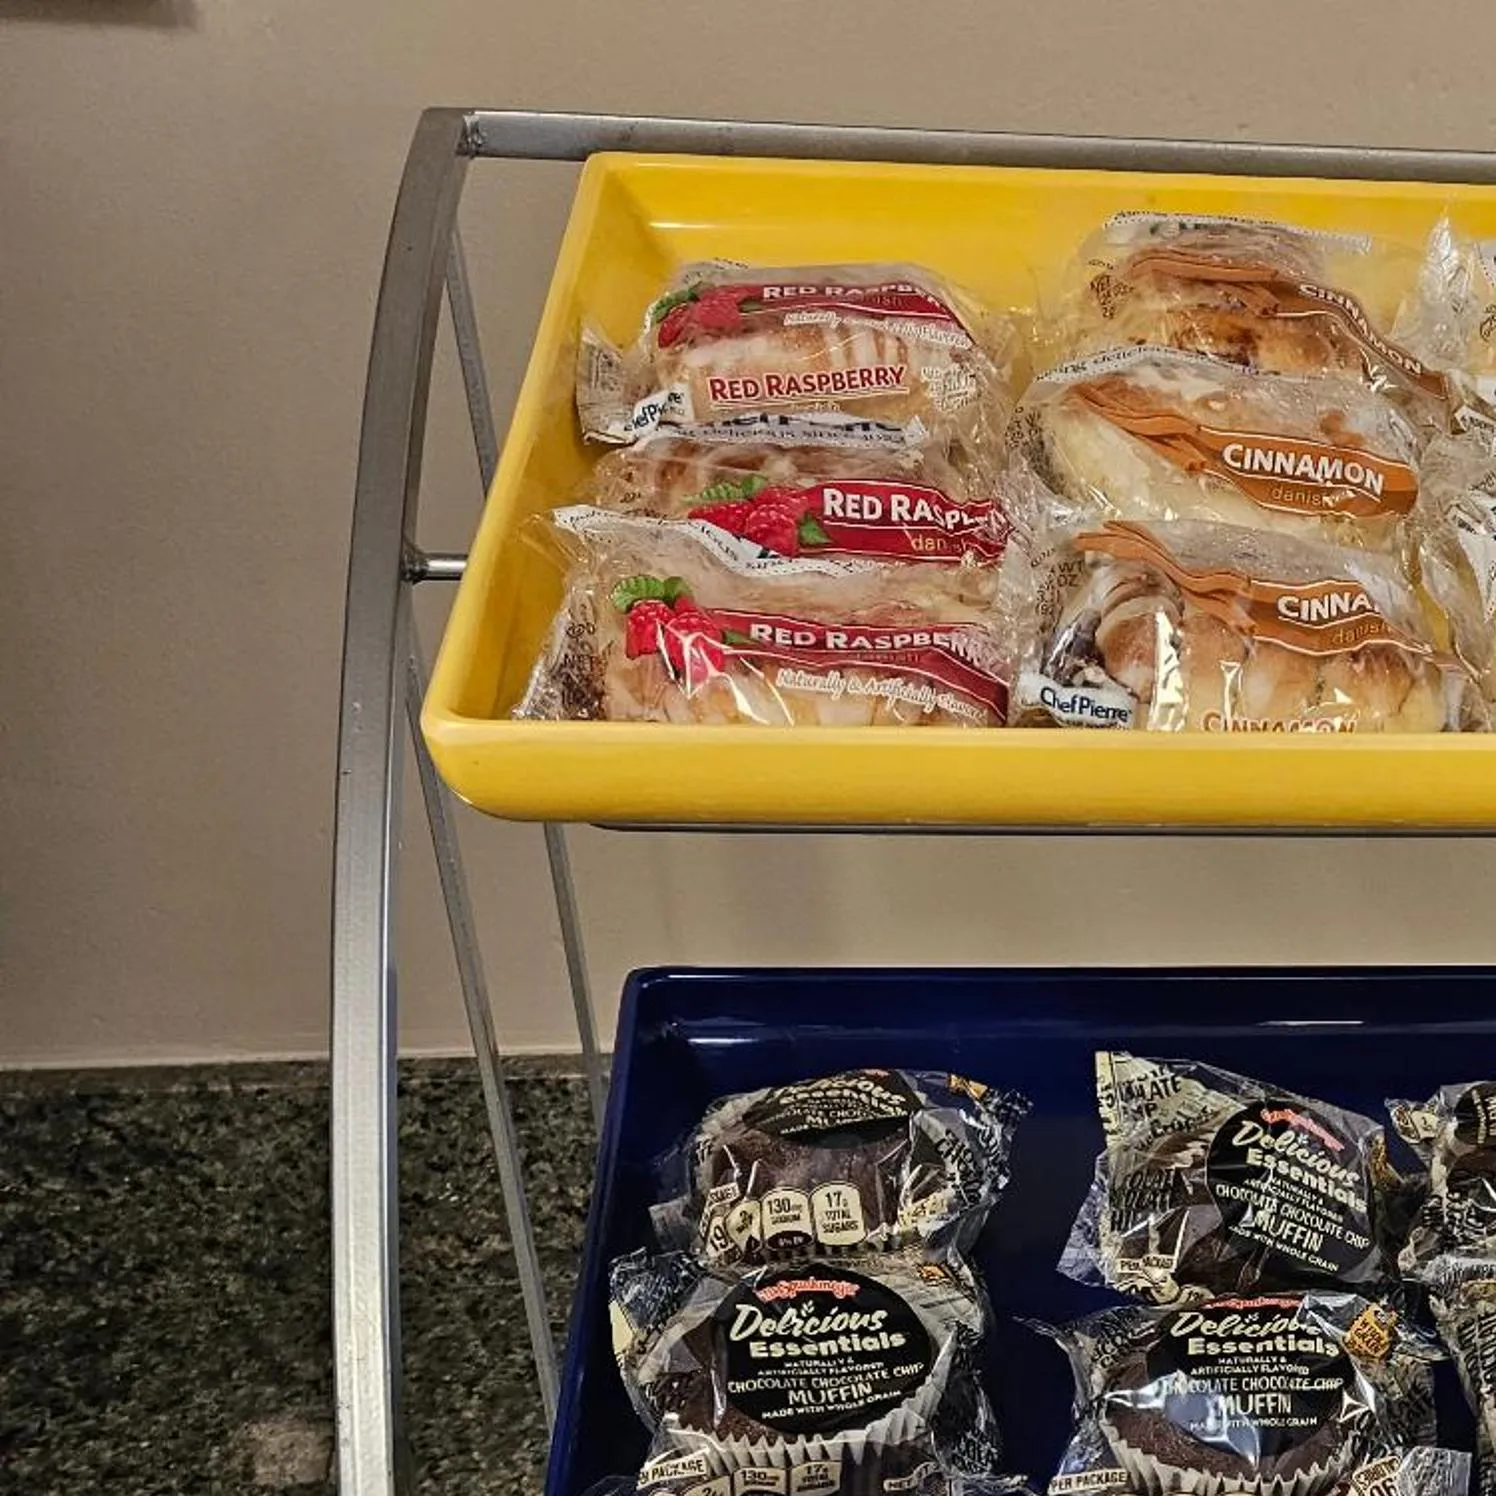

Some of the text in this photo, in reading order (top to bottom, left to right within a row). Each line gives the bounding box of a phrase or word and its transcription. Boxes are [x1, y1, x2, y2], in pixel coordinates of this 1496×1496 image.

[763, 286, 817, 299] RED
[709, 377, 759, 401] RED
[766, 366, 905, 396] RASPBERRY
[1223, 443, 1386, 496] CINNAMON
[823, 488, 882, 520] RED
[1277, 592, 1380, 622] CINNA
[750, 623, 817, 646] RED
[776, 668, 847, 700] Naturally
[1040, 687, 1129, 720] ChefPierre
[1232, 1120, 1361, 1187] Delicious
[1246, 1148, 1367, 1214] Essentials
[1254, 1210, 1324, 1252] MUFFIN
[729, 1304, 888, 1341] Delicious
[750, 1332, 906, 1358] Essentials
[1187, 1334, 1340, 1358] Essentials
[727, 1377, 806, 1393] CHOCOLATE
[811, 1369, 890, 1389] CHOCOLATE
[788, 1382, 873, 1405] MUFFIN
[1077, 1470, 1126, 1488] PACKAGE
